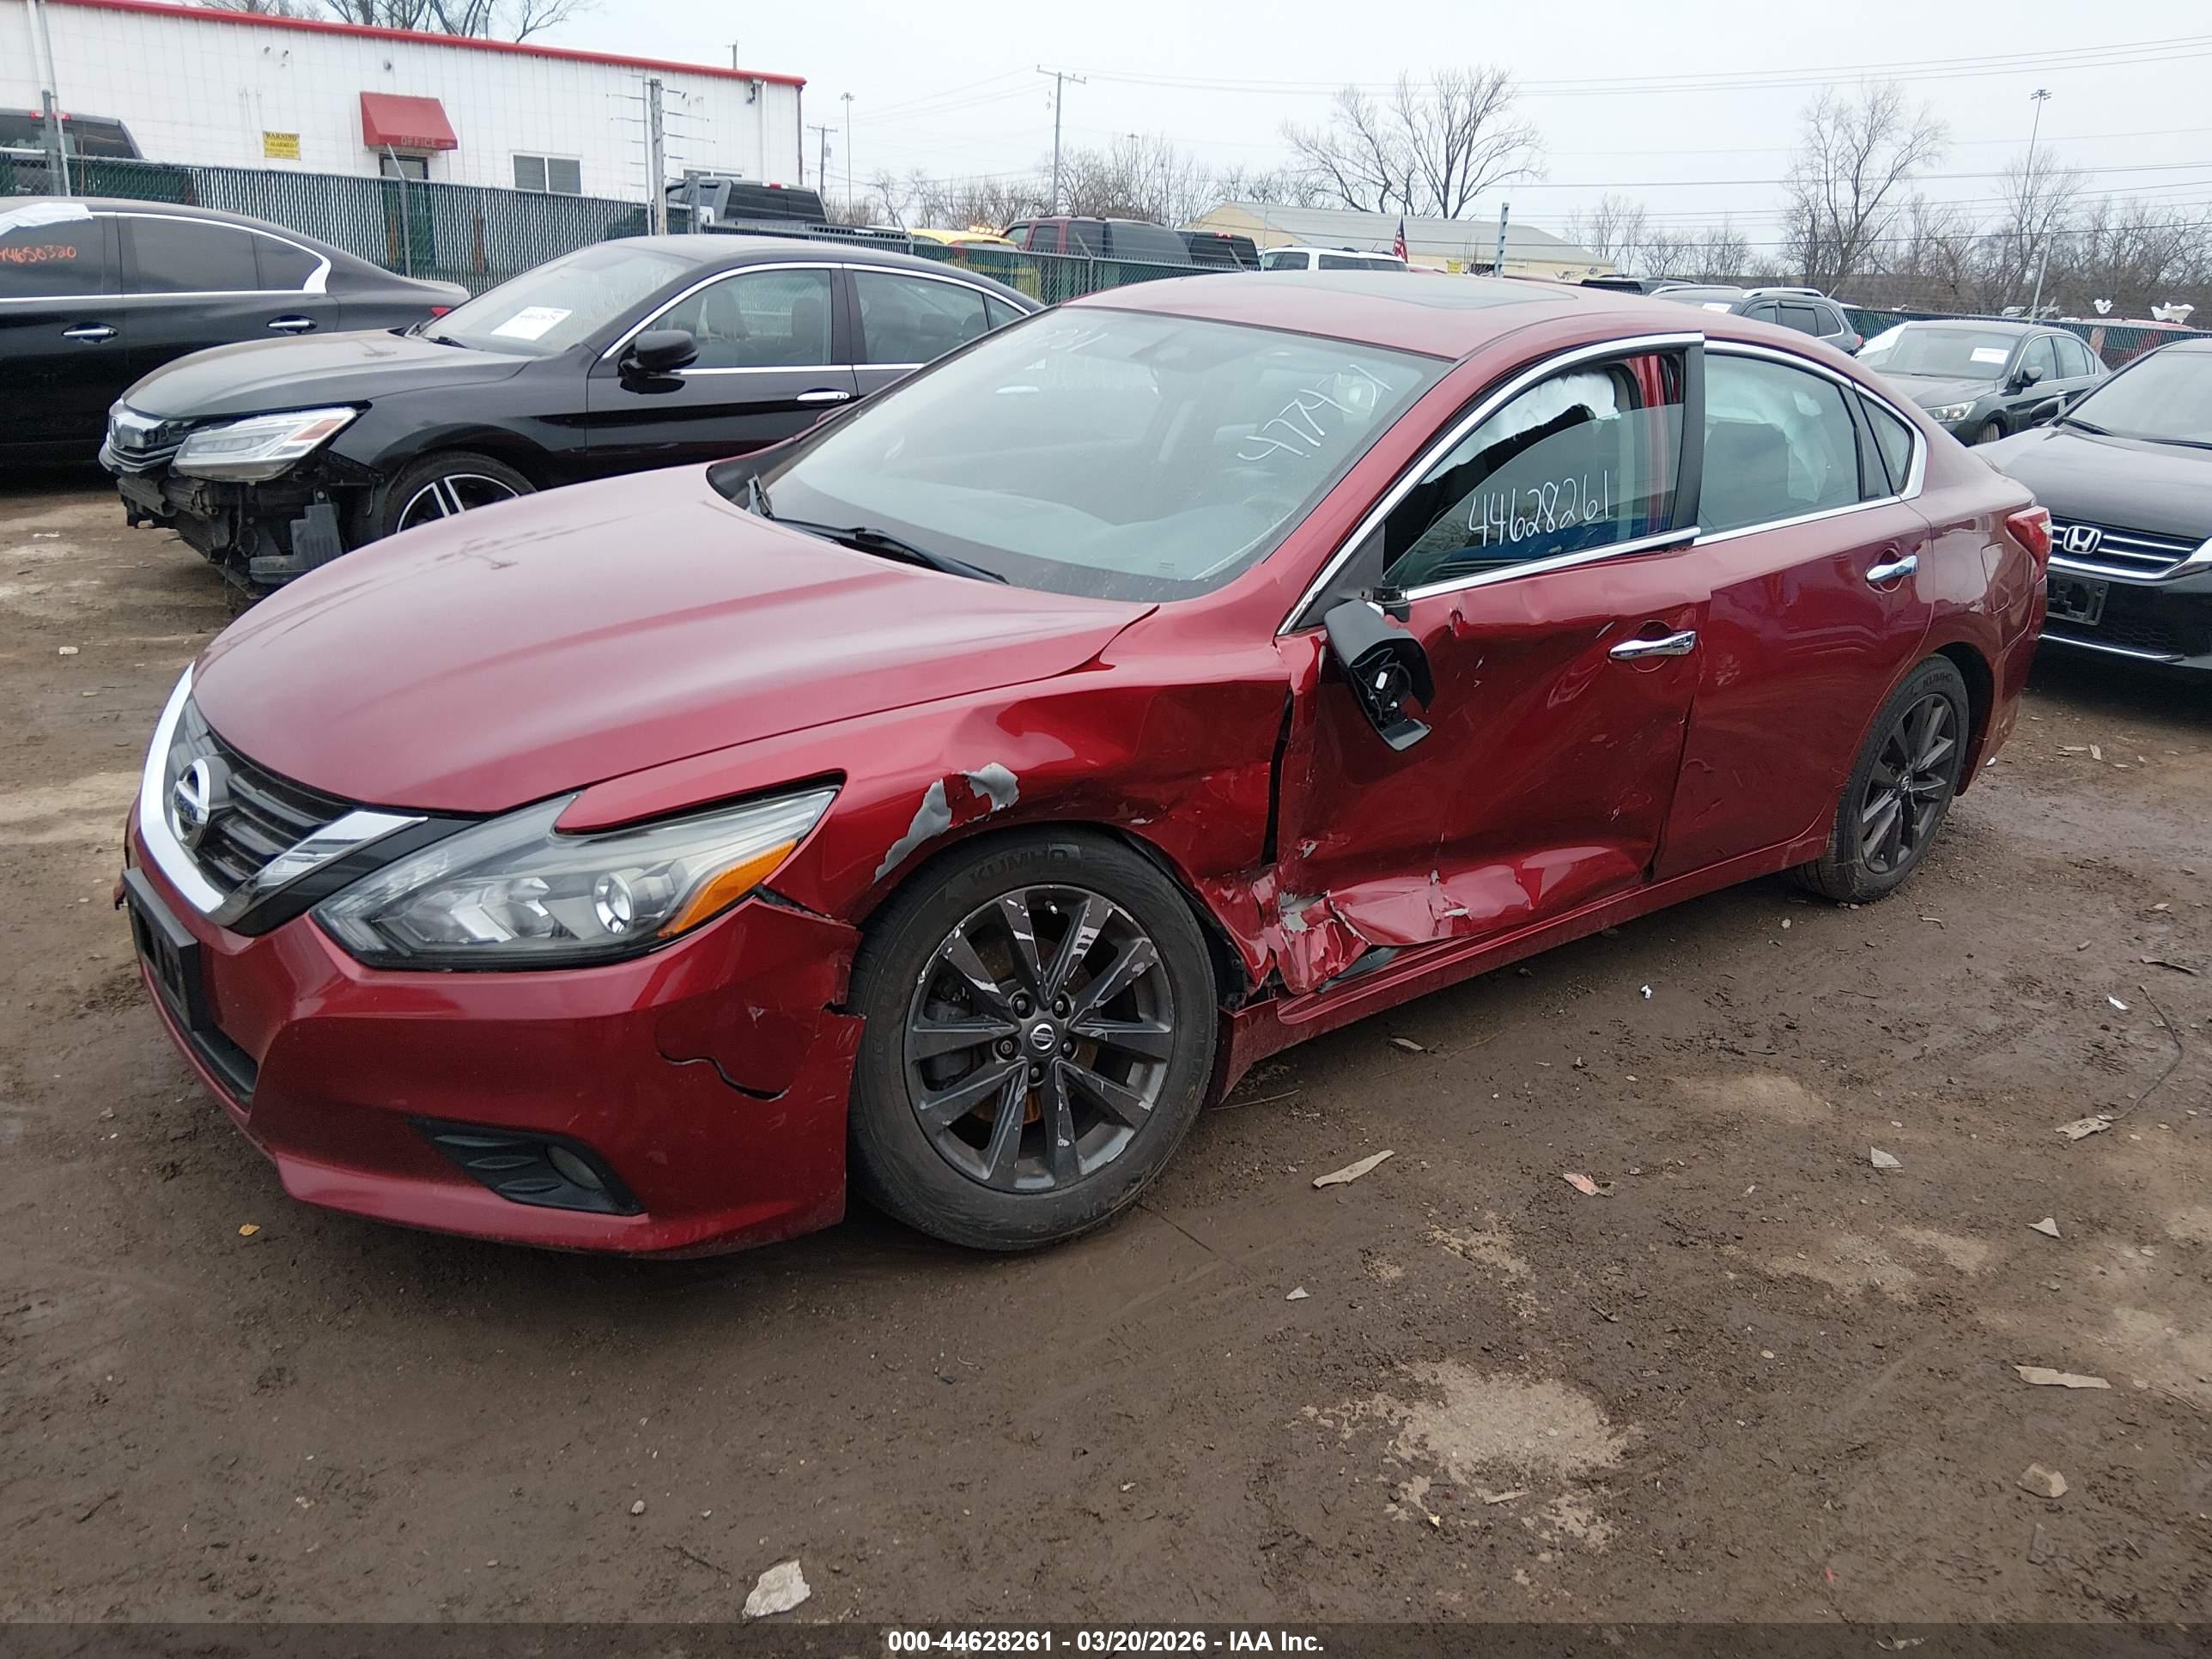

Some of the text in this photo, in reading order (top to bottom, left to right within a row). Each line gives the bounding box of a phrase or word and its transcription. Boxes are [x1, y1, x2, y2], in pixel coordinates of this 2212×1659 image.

[265, 132, 297, 142] WARNING
[400, 136, 437, 148] OFFICE
[1468, 470, 1608, 547] 44628261
[969, 848, 1069, 886] KUMHO
